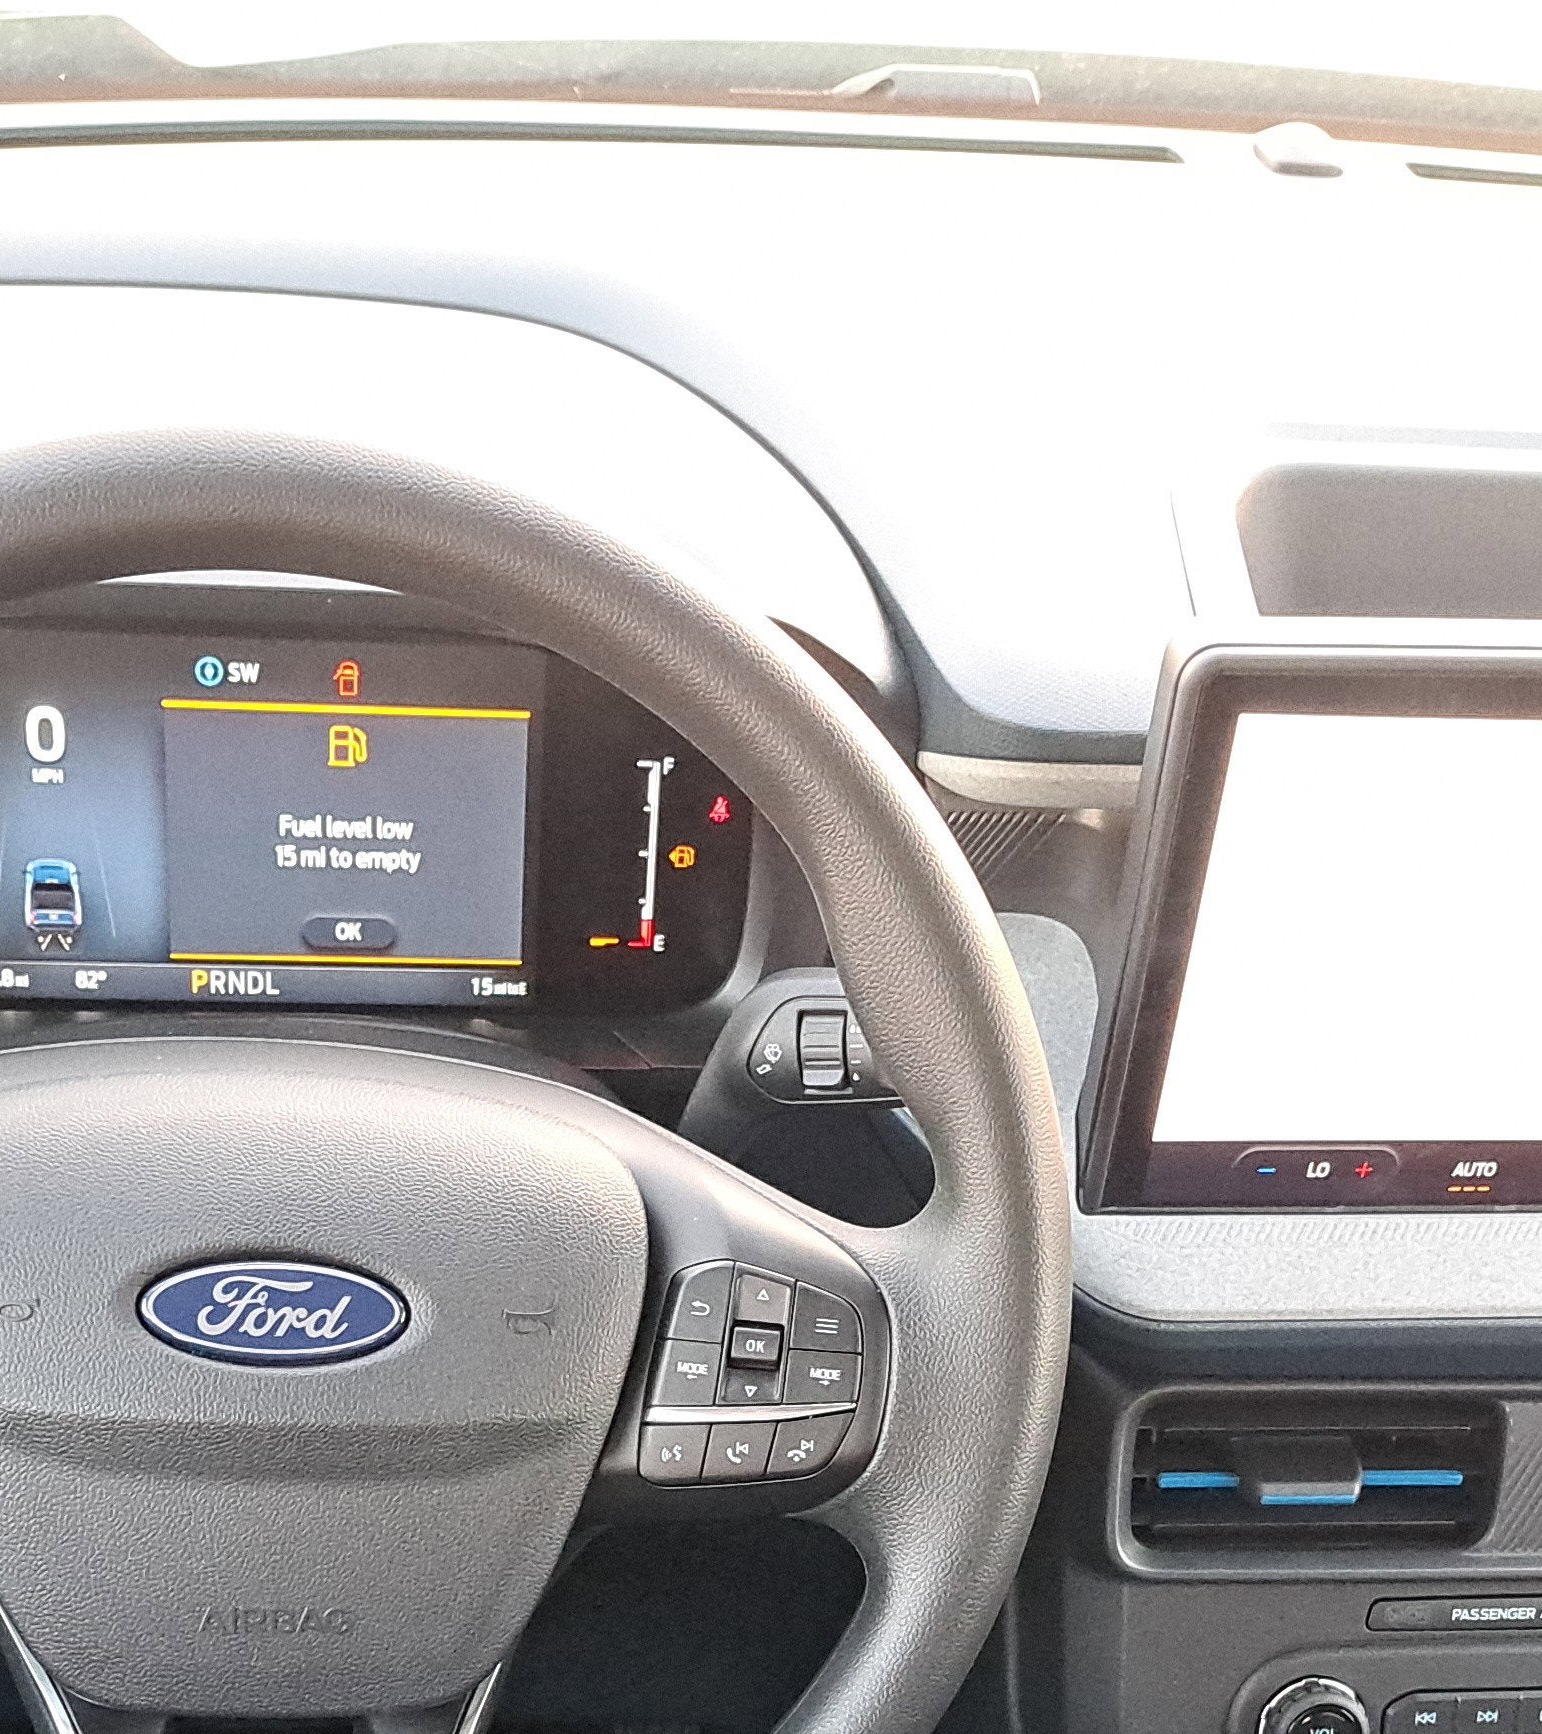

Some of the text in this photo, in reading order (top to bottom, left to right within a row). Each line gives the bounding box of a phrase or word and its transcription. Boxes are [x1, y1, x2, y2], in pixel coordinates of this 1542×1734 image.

[227, 662, 260, 684] SW
[25, 704, 66, 763] 0
[278, 815, 413, 840] Fuel level low
[275, 845, 421, 874] 15 mi to empty
[334, 921, 362, 941] OK
[1305, 1161, 1331, 1178] LO
[1451, 1161, 1498, 1178] AUTO
[196, 1275, 352, 1339] Ford
[745, 1339, 765, 1354] OK
[677, 1361, 709, 1375] MODE
[809, 1367, 841, 1381] MODE
[197, 1605, 351, 1636] AIRBAG
[1451, 1608, 1536, 1621] PASSENGER
